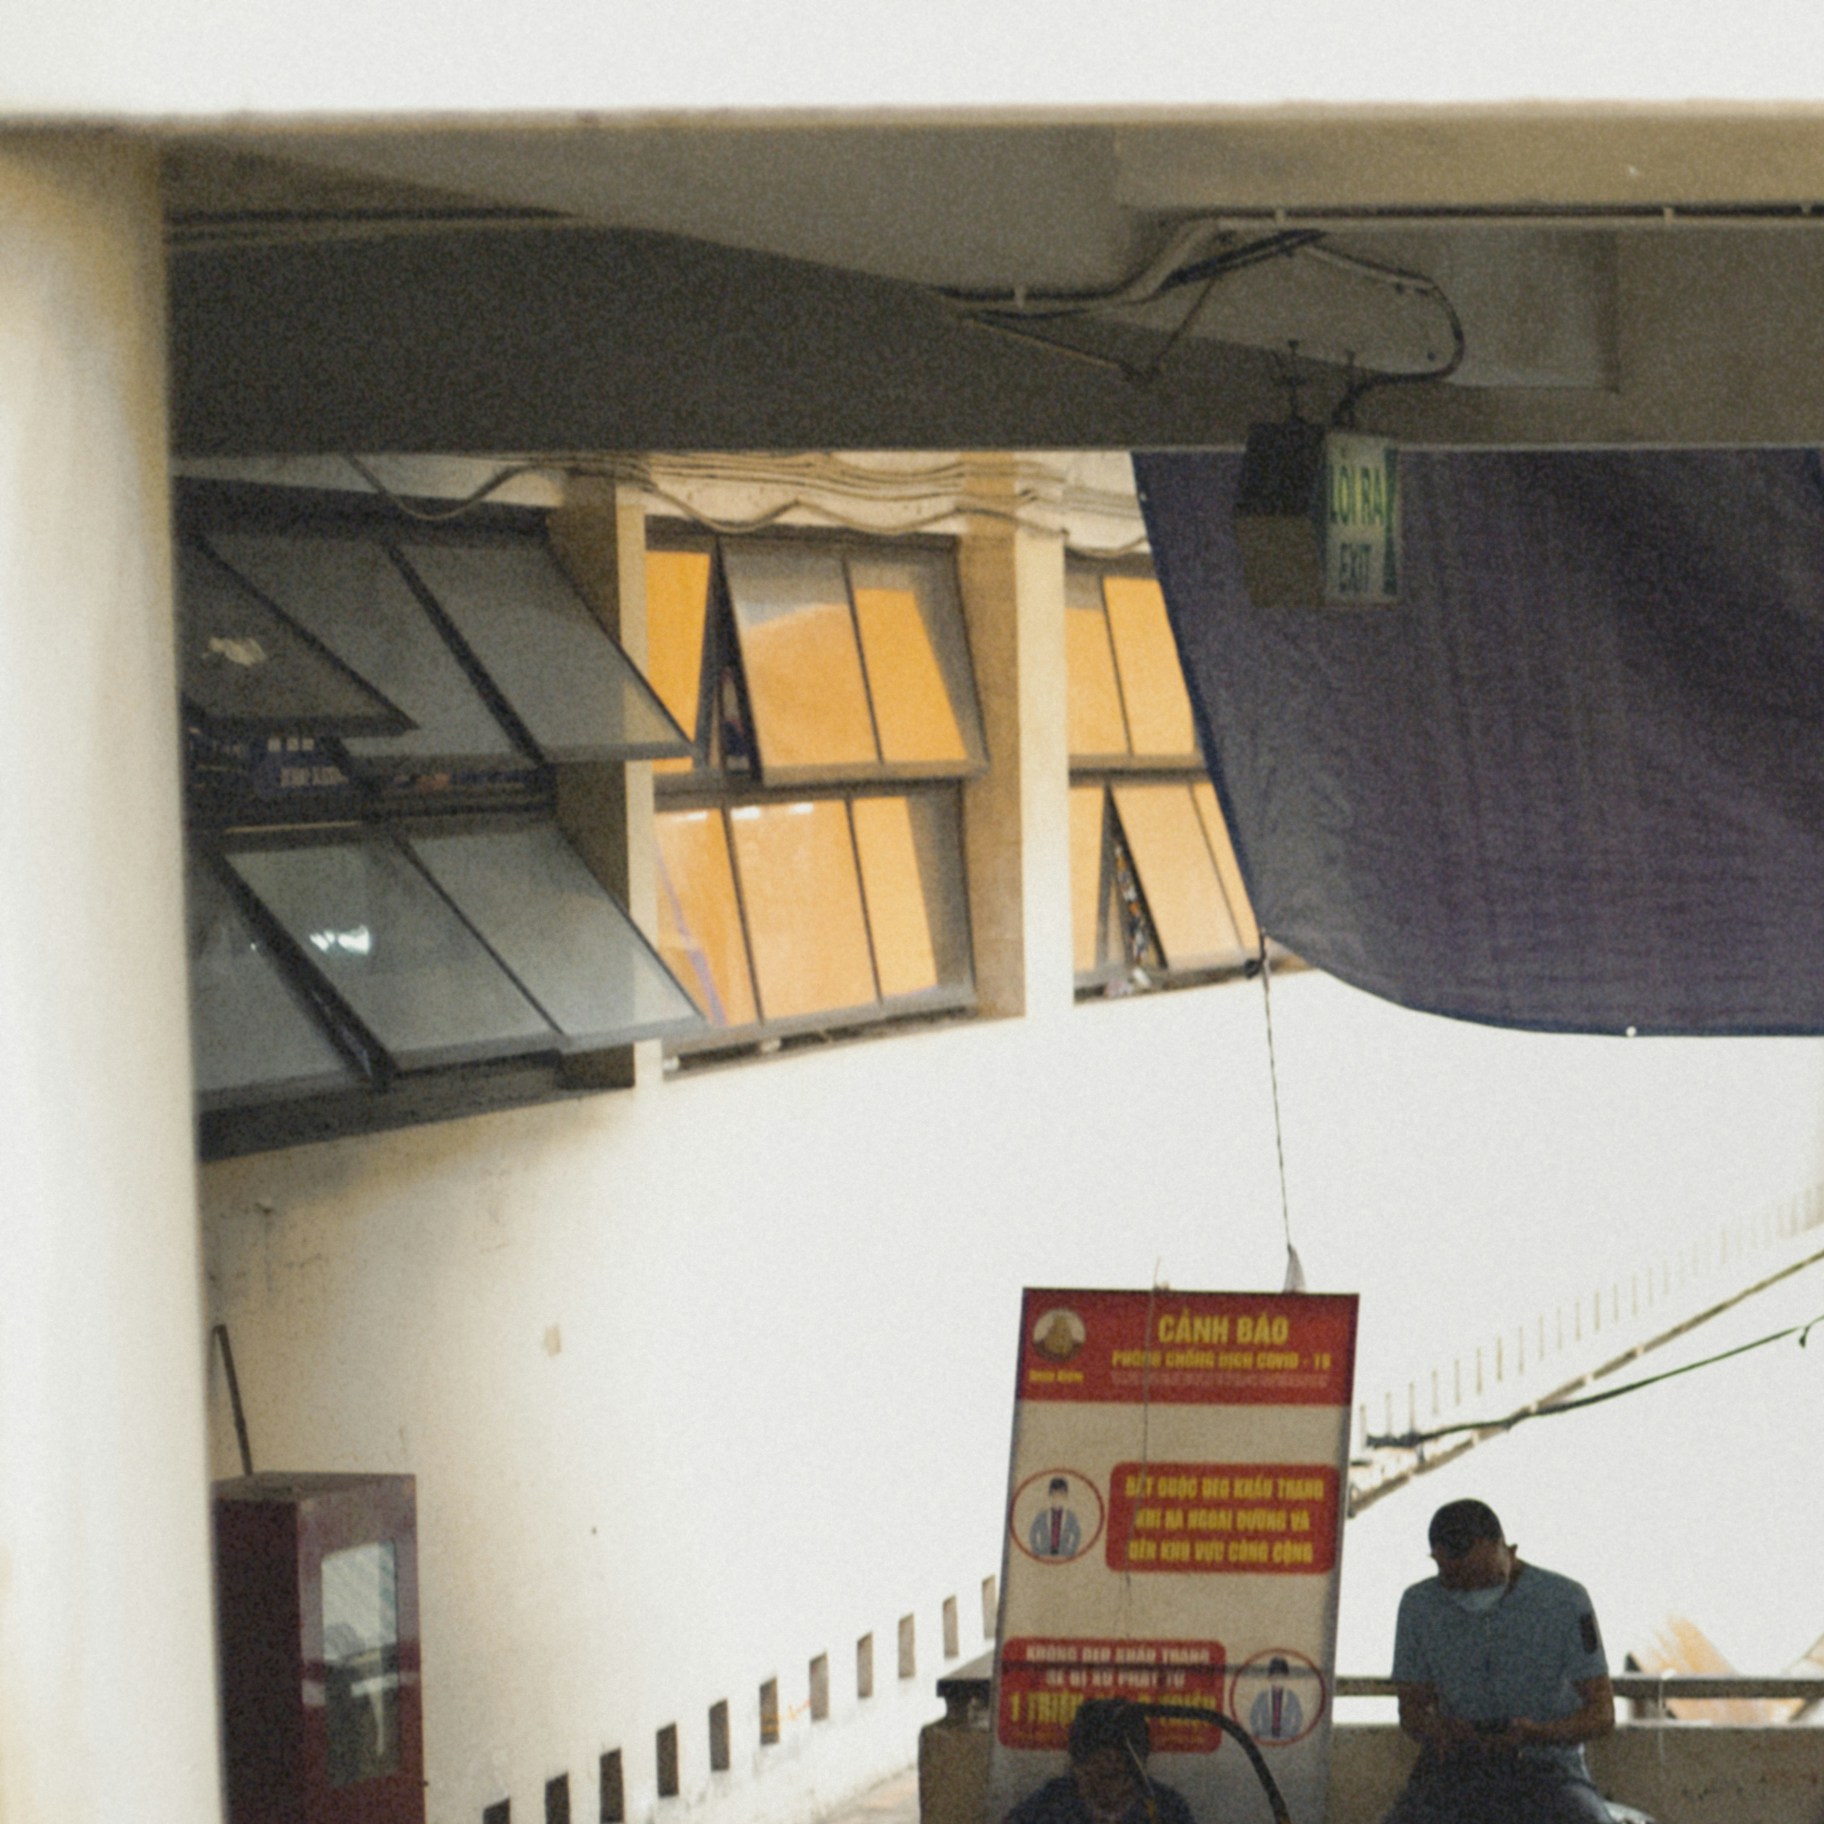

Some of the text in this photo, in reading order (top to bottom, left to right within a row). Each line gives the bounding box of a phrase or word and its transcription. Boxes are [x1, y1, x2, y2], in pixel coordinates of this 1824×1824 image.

[1339, 541, 1372, 593] EXIT
[1157, 1307, 1290, 1346] CẢNH BÁO
[1257, 1351, 1300, 1370] COVID
